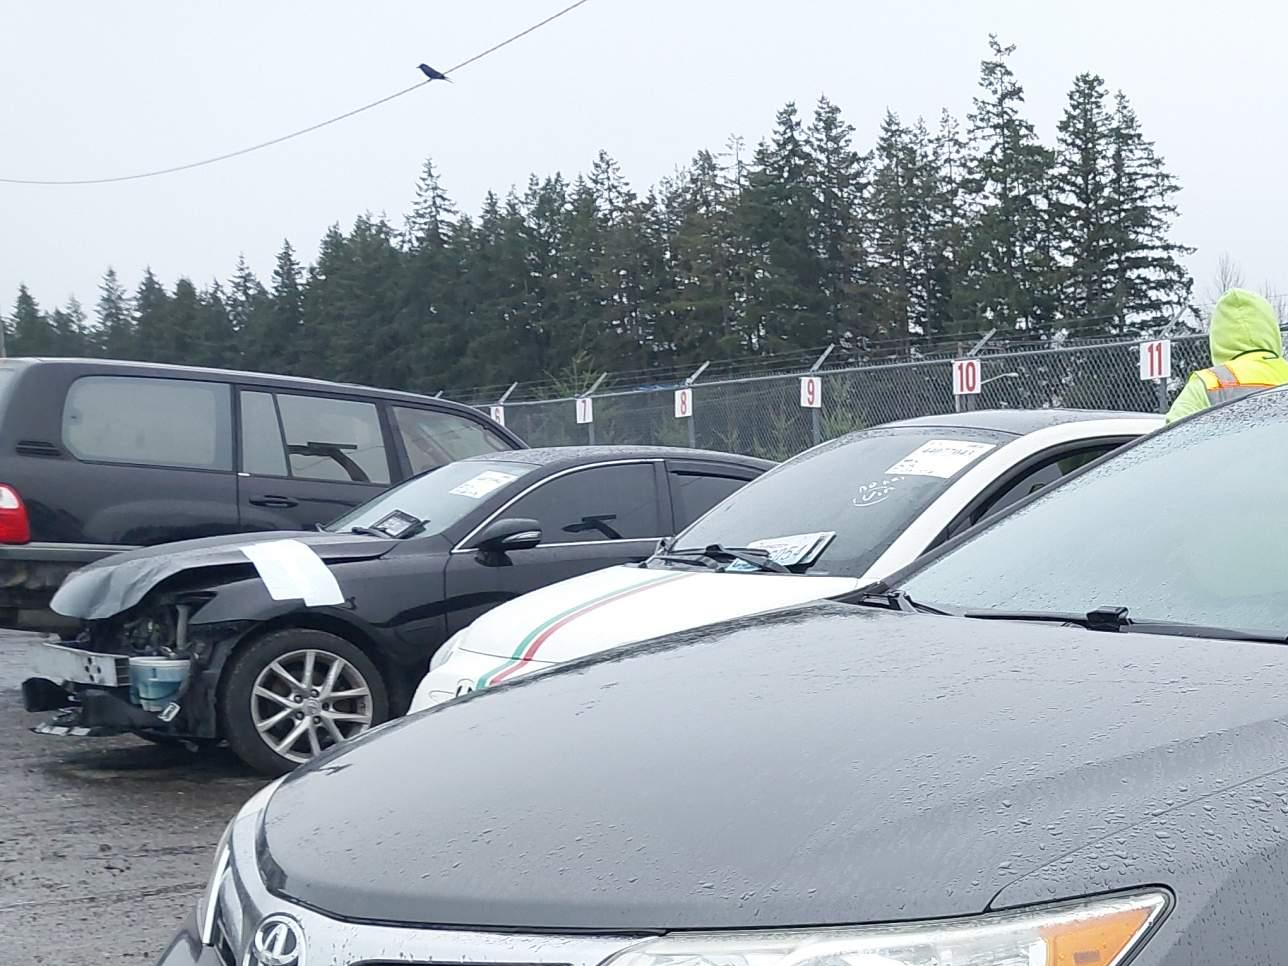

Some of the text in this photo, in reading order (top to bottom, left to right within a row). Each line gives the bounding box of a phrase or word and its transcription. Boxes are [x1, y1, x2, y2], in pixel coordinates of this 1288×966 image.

[1147, 342, 1163, 377] 11
[957, 361, 976, 393] 10
[680, 391, 687, 415] 8
[807, 379, 815, 406] 9
[581, 400, 588, 421] 7
